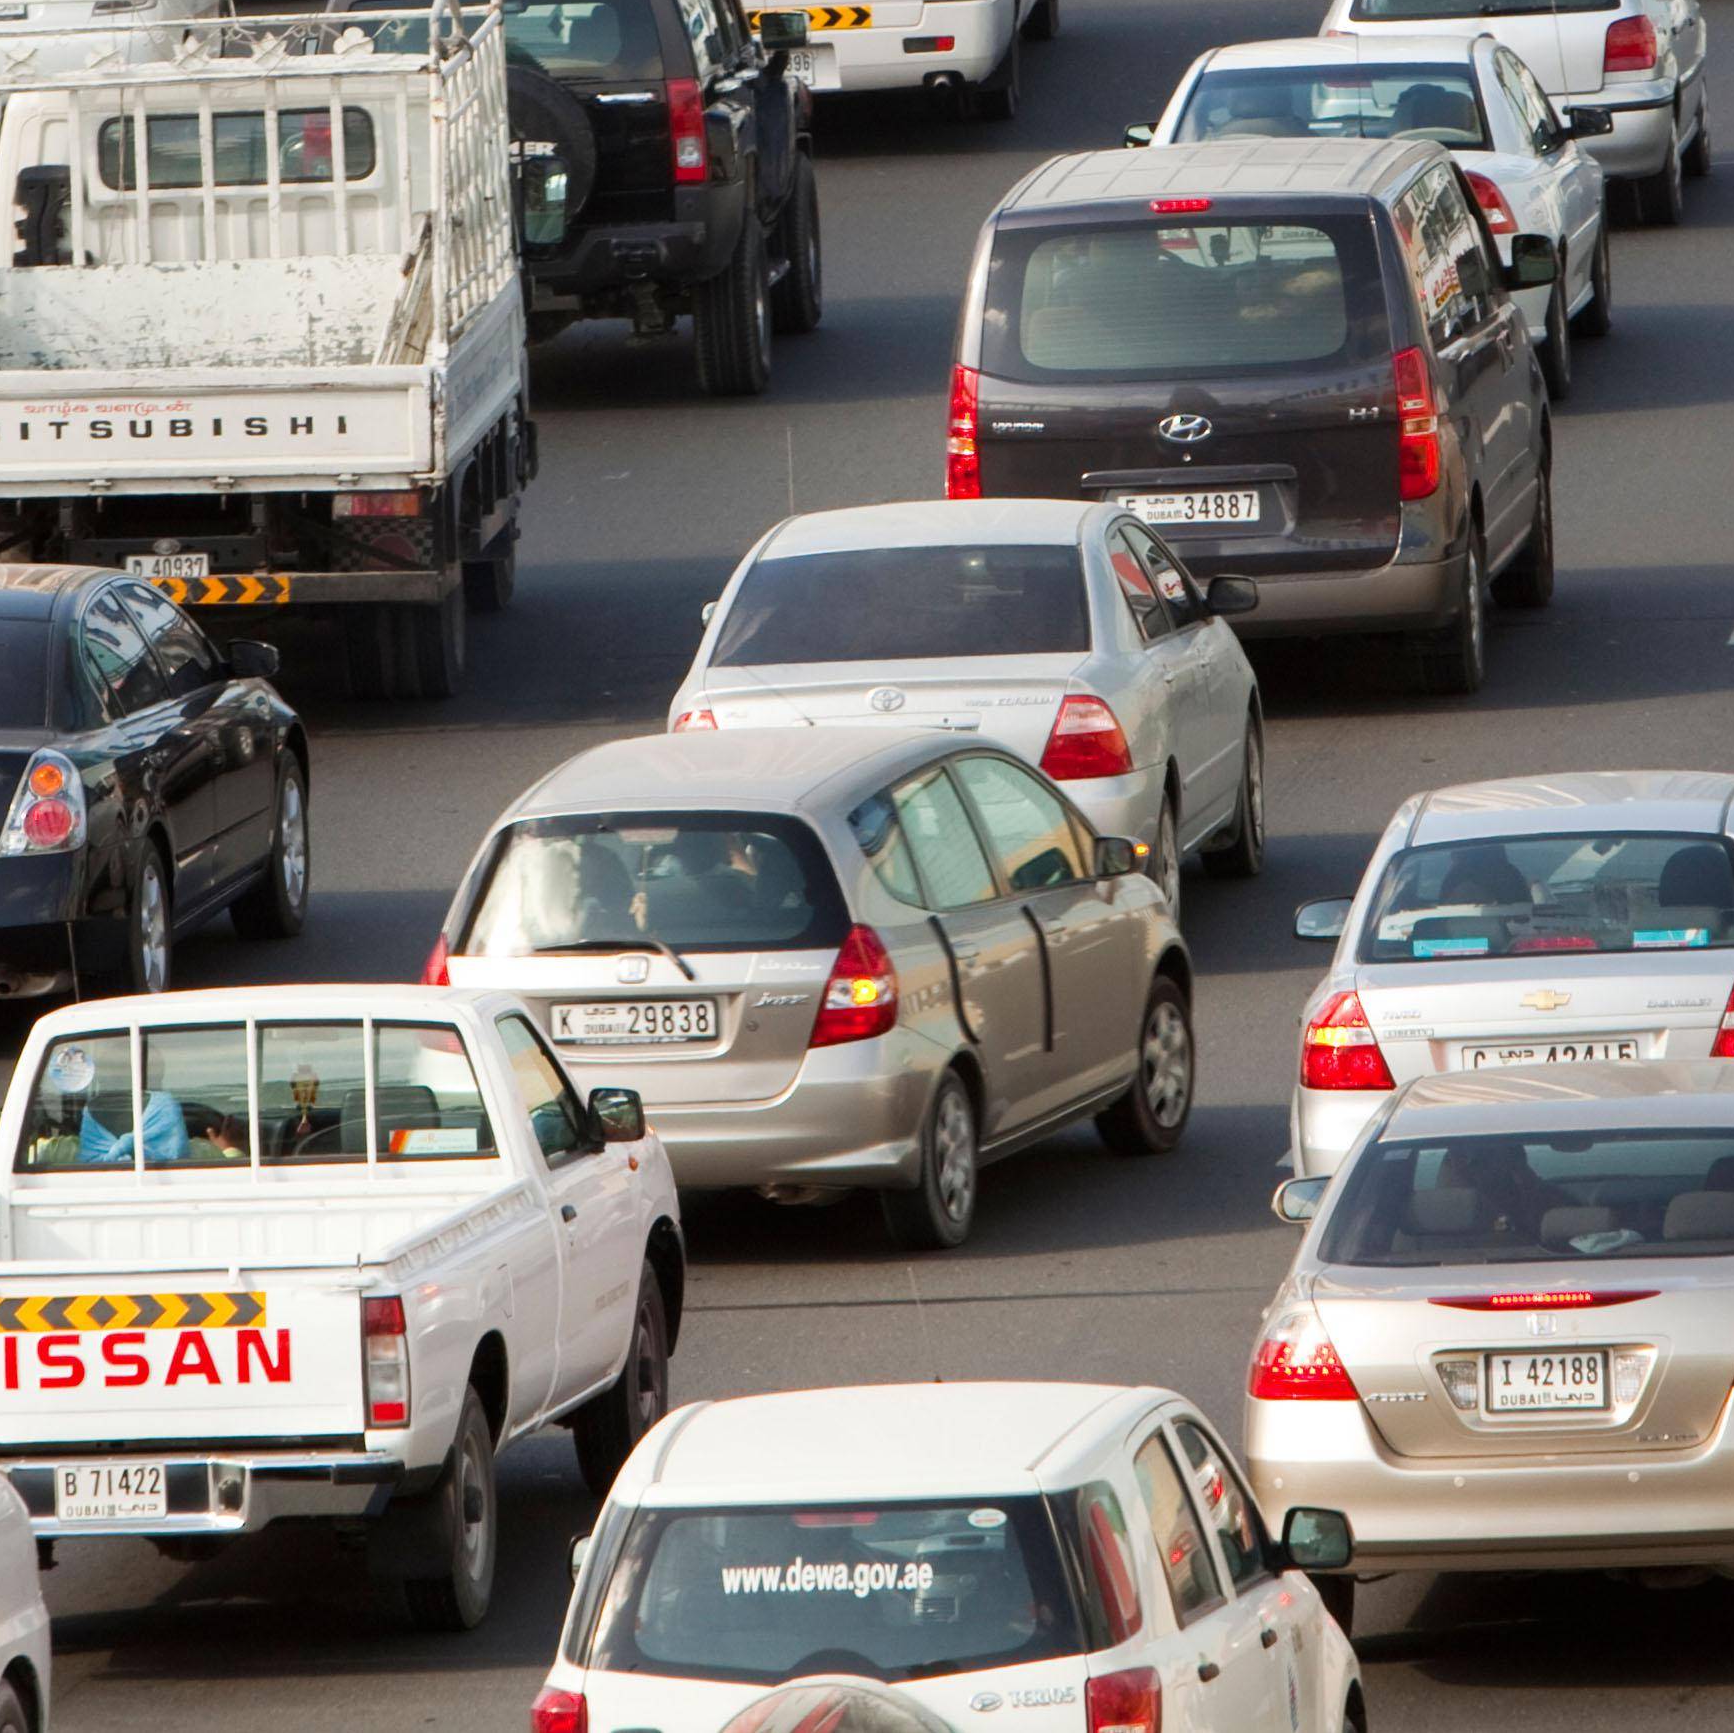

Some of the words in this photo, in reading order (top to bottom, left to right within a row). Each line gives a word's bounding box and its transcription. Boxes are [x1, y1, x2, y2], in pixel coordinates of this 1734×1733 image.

[1184, 494, 1254, 520] 34887
[153, 557, 205, 578] 40937
[560, 1011, 572, 1034] K
[627, 1004, 709, 1034] 29838
[1502, 1360, 1512, 1386] I
[1527, 1356, 1598, 1386] 42188
[1501, 1392, 1541, 1406] DUBAI
[65, 1472, 77, 1497] B
[90, 1468, 161, 1497] 71422
[66, 1505, 105, 1517] DUBAI
[722, 1556, 934, 1598] www.dewa.gov.ae
